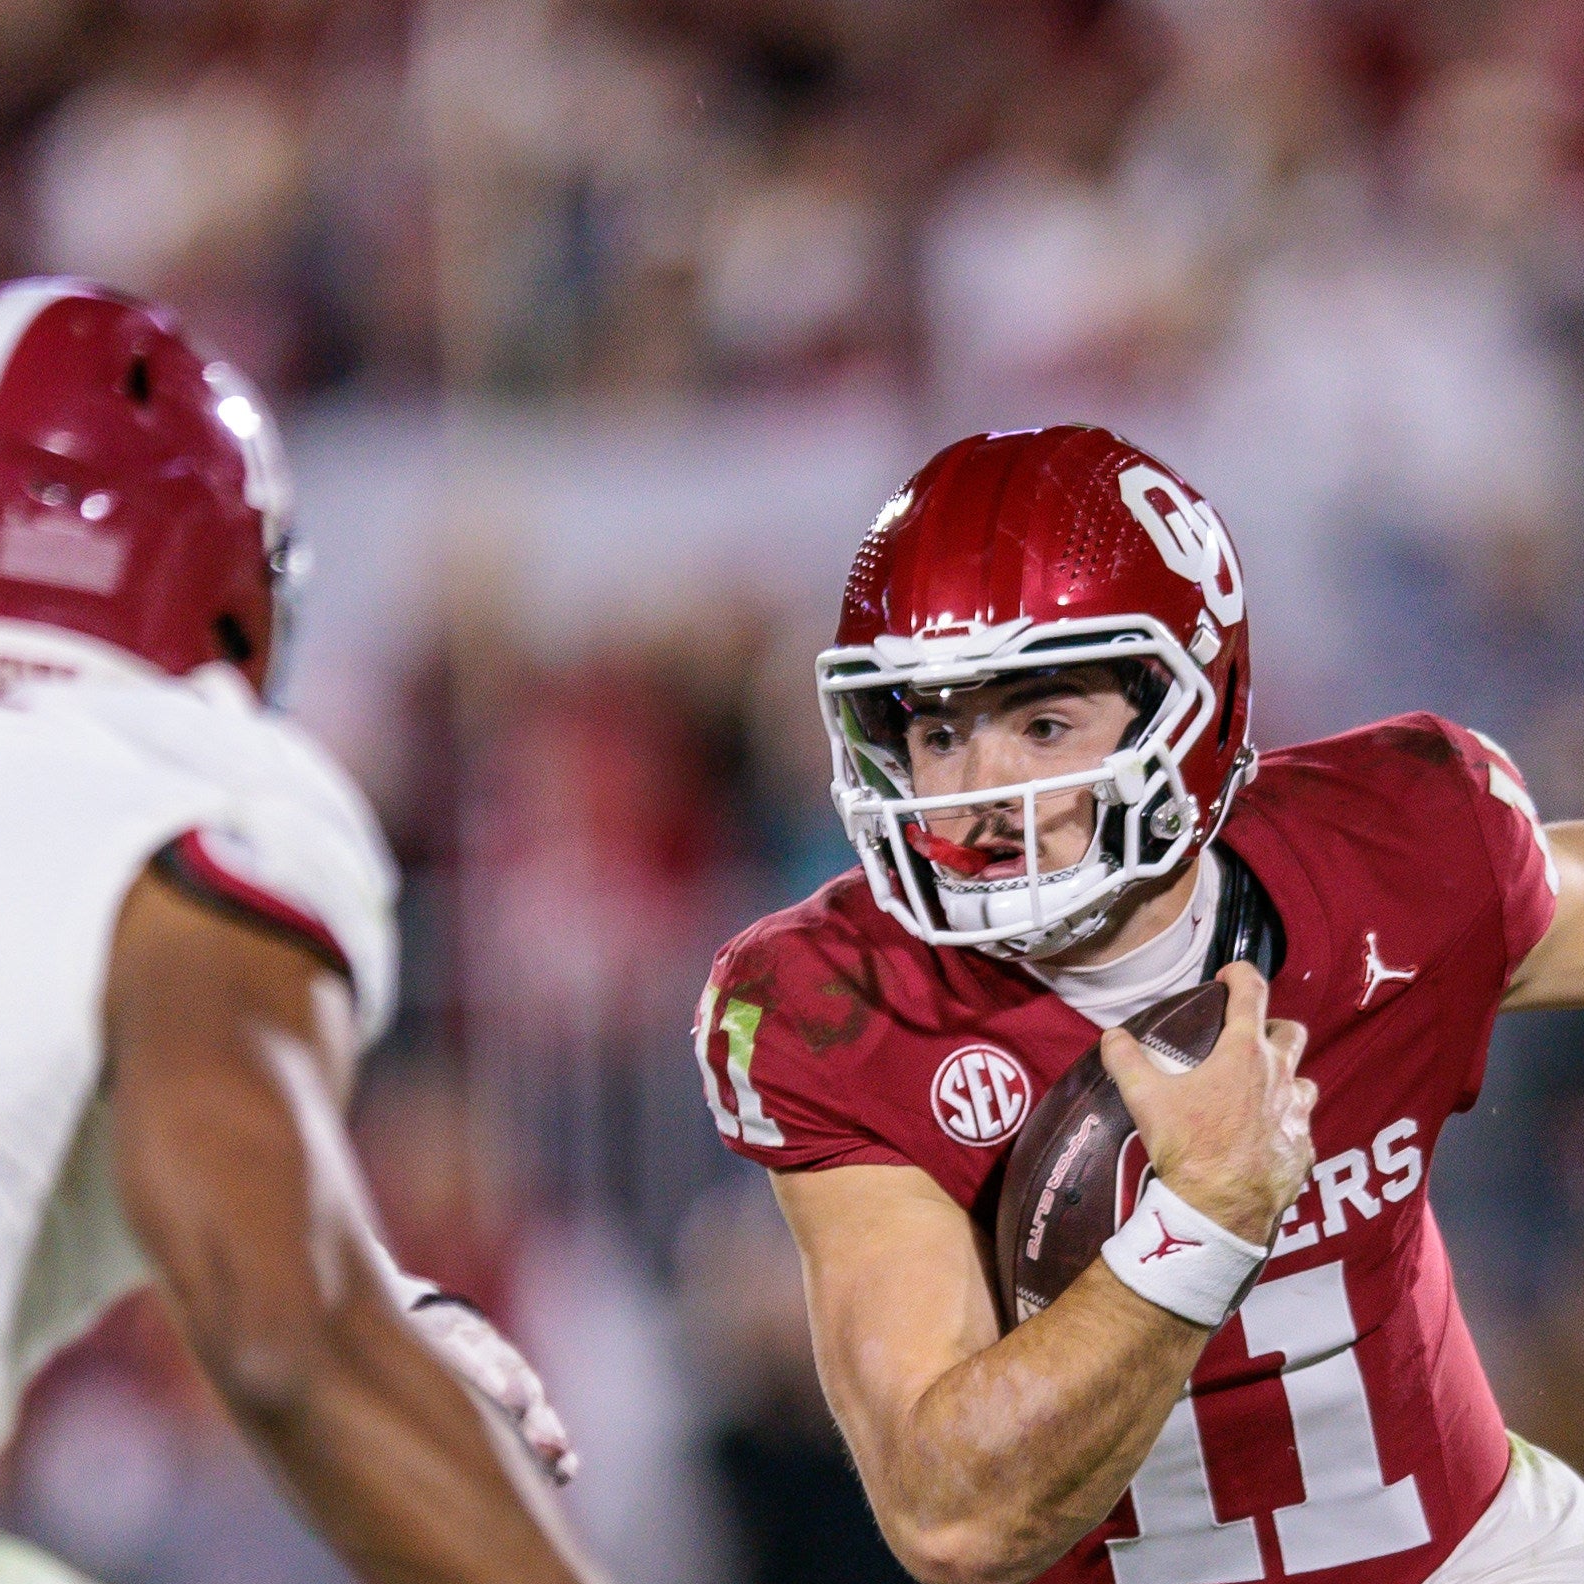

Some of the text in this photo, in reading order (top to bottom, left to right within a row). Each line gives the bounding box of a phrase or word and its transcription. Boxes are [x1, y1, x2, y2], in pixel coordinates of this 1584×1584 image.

[1118, 464, 1245, 627] OU
[694, 986, 785, 1147] 11
[939, 1052, 1023, 1140] SEC
[1025, 1113, 1101, 1261] VAPOR ELITE
